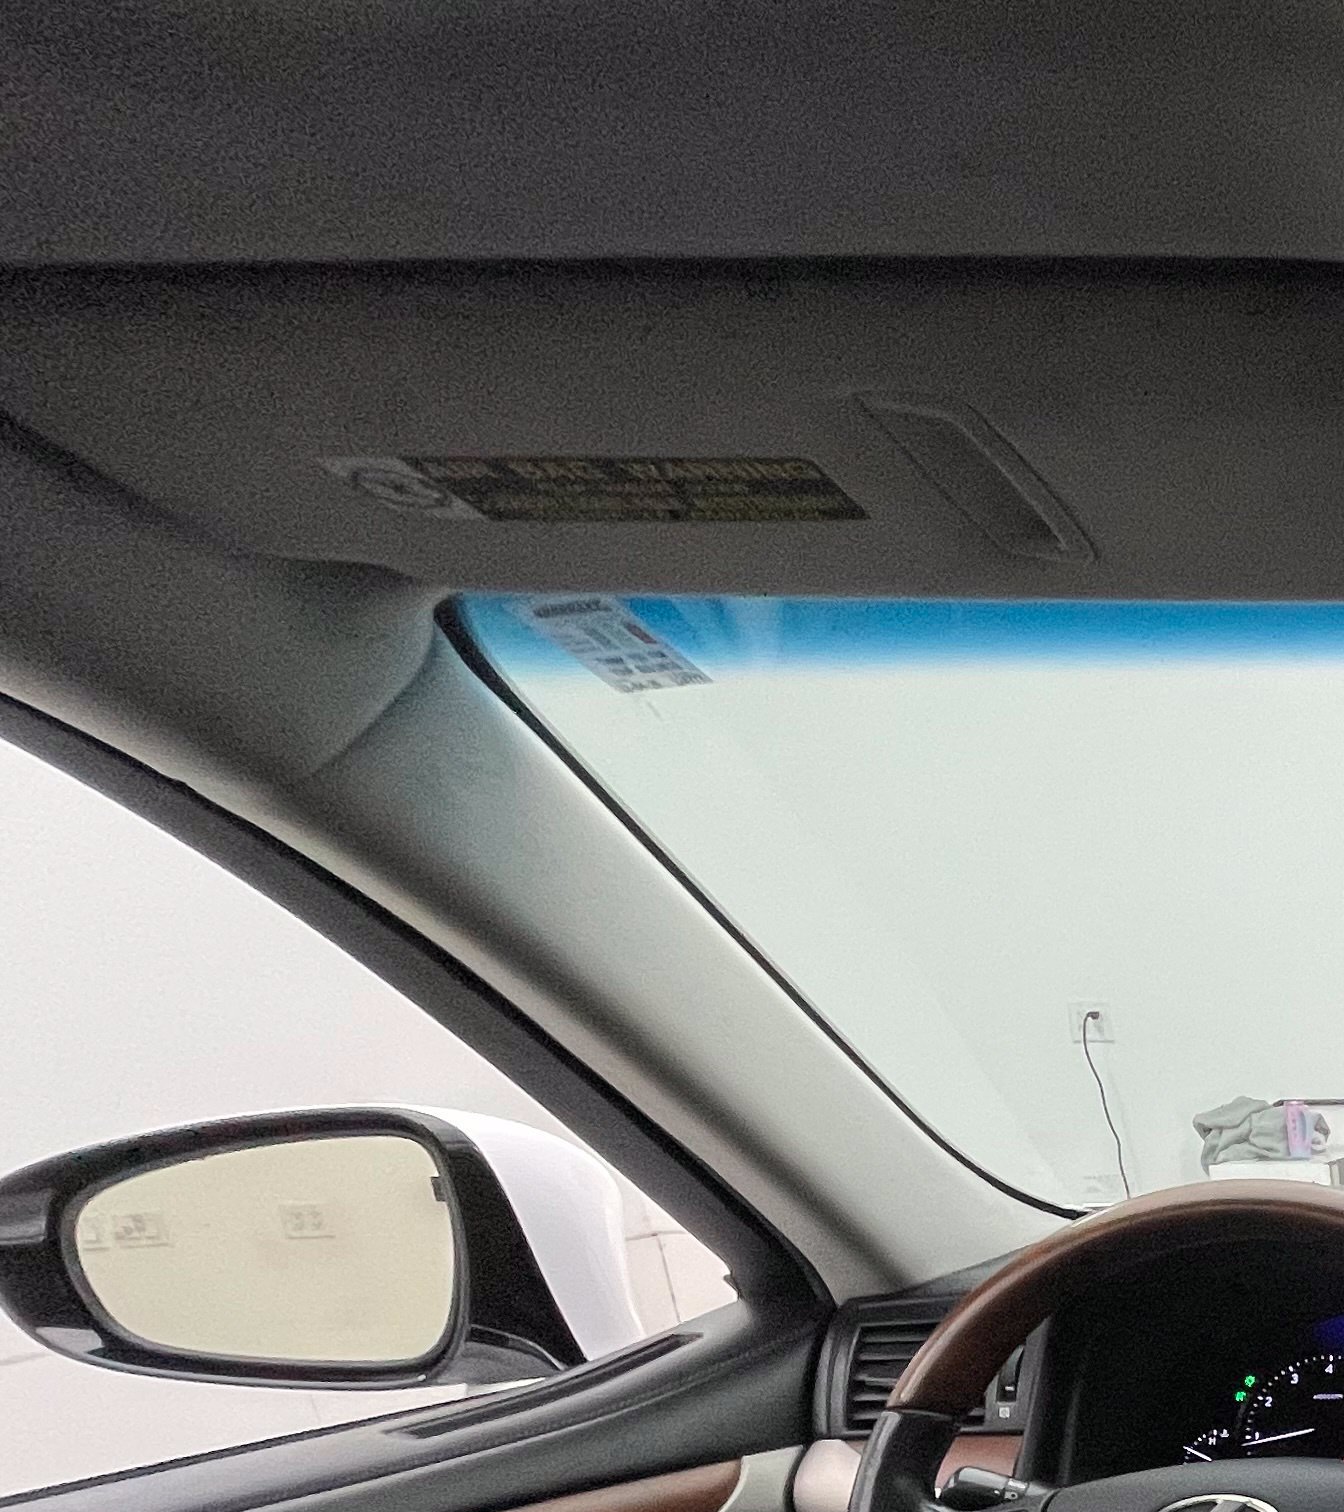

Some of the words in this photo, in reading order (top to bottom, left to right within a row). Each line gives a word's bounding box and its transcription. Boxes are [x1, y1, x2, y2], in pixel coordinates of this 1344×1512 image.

[1325, 1364, 1334, 1374] 4
[1290, 1373, 1299, 1385] 3
[1264, 1396, 1273, 1407] 2
